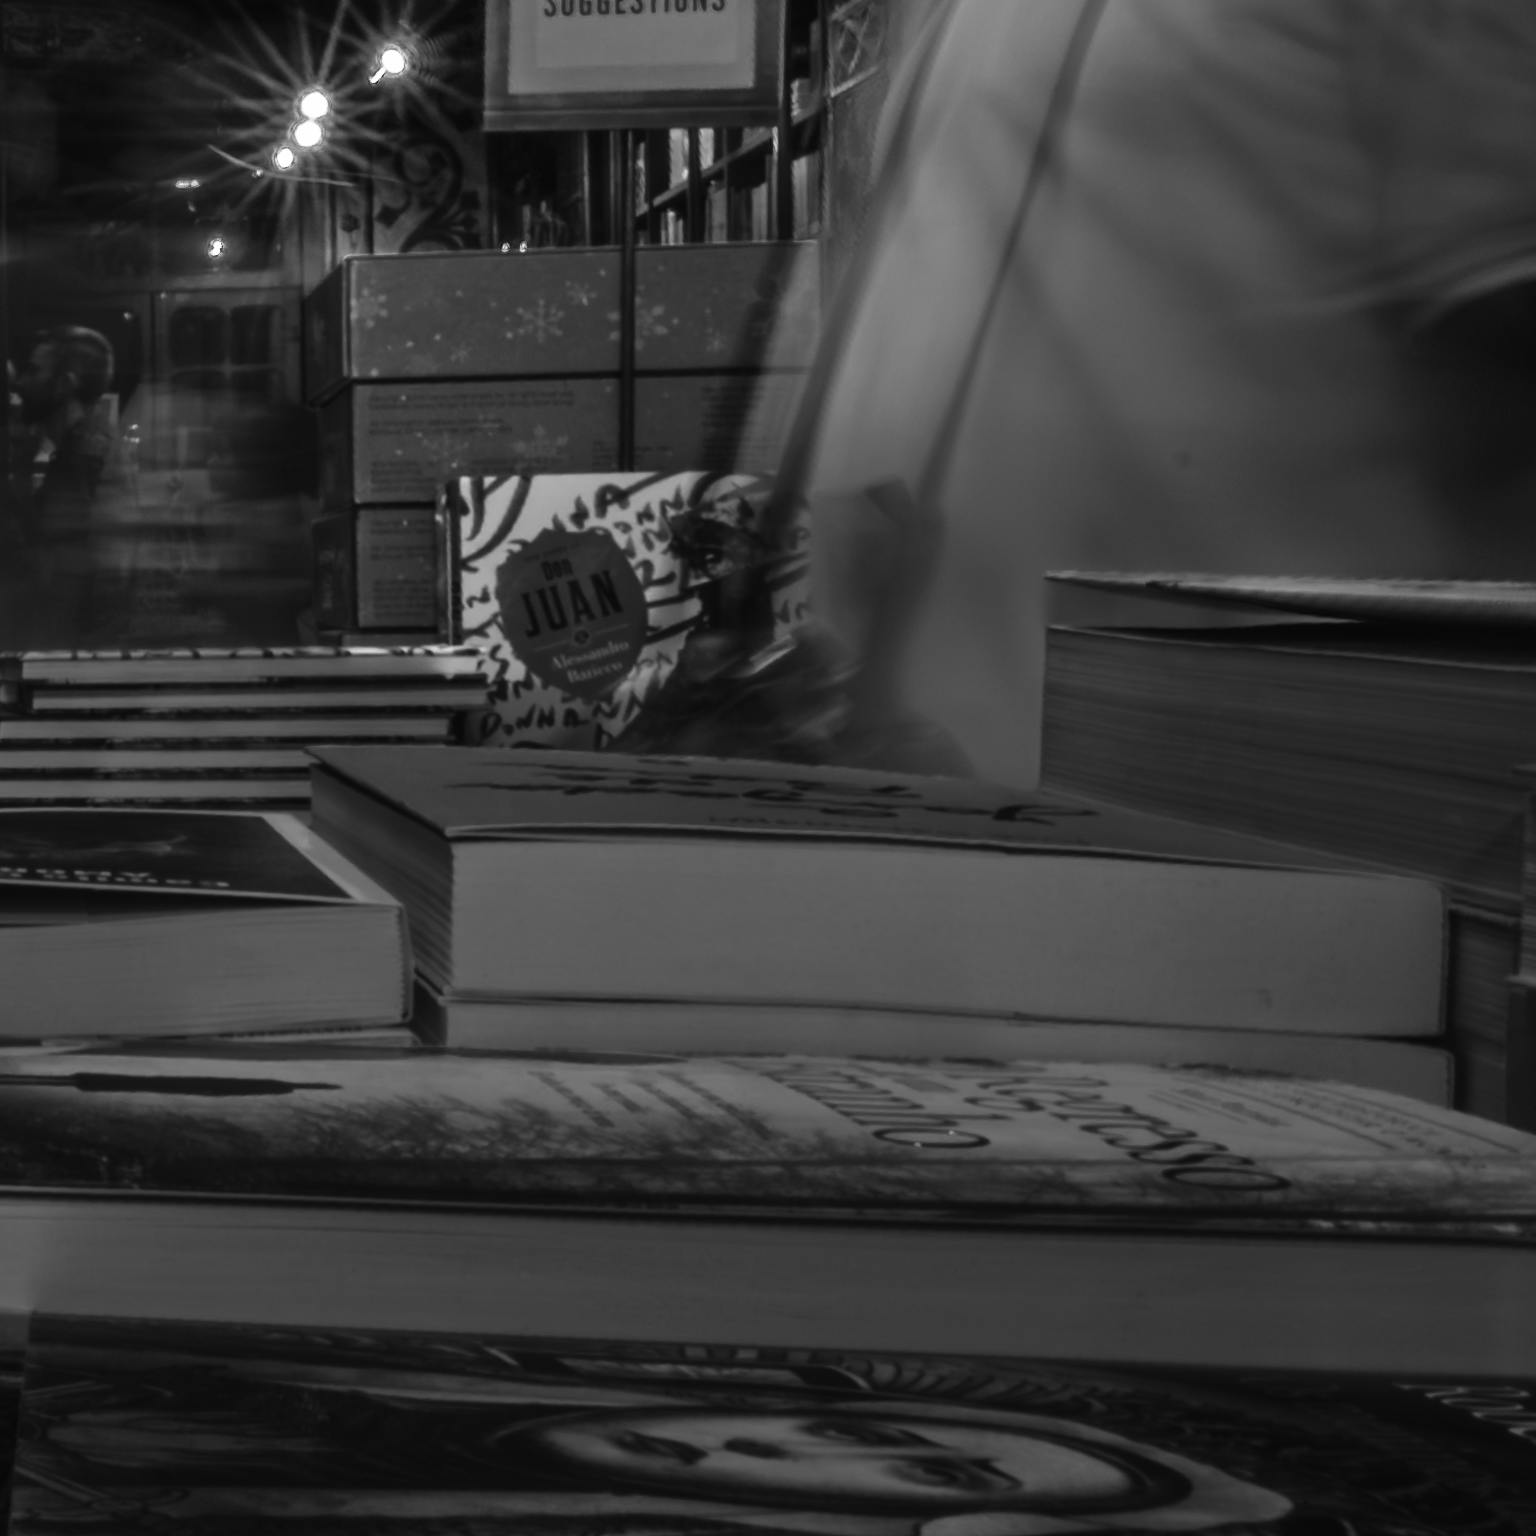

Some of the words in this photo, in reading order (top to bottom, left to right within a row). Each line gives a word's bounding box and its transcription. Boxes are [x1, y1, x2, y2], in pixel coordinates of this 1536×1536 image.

[540, 558, 573, 581] Don
[520, 570, 622, 637] JUAN
[551, 641, 630, 670] Alessandro
[567, 662, 623, 684] Baricco
[945, 1073, 1294, 1192] Regresso
